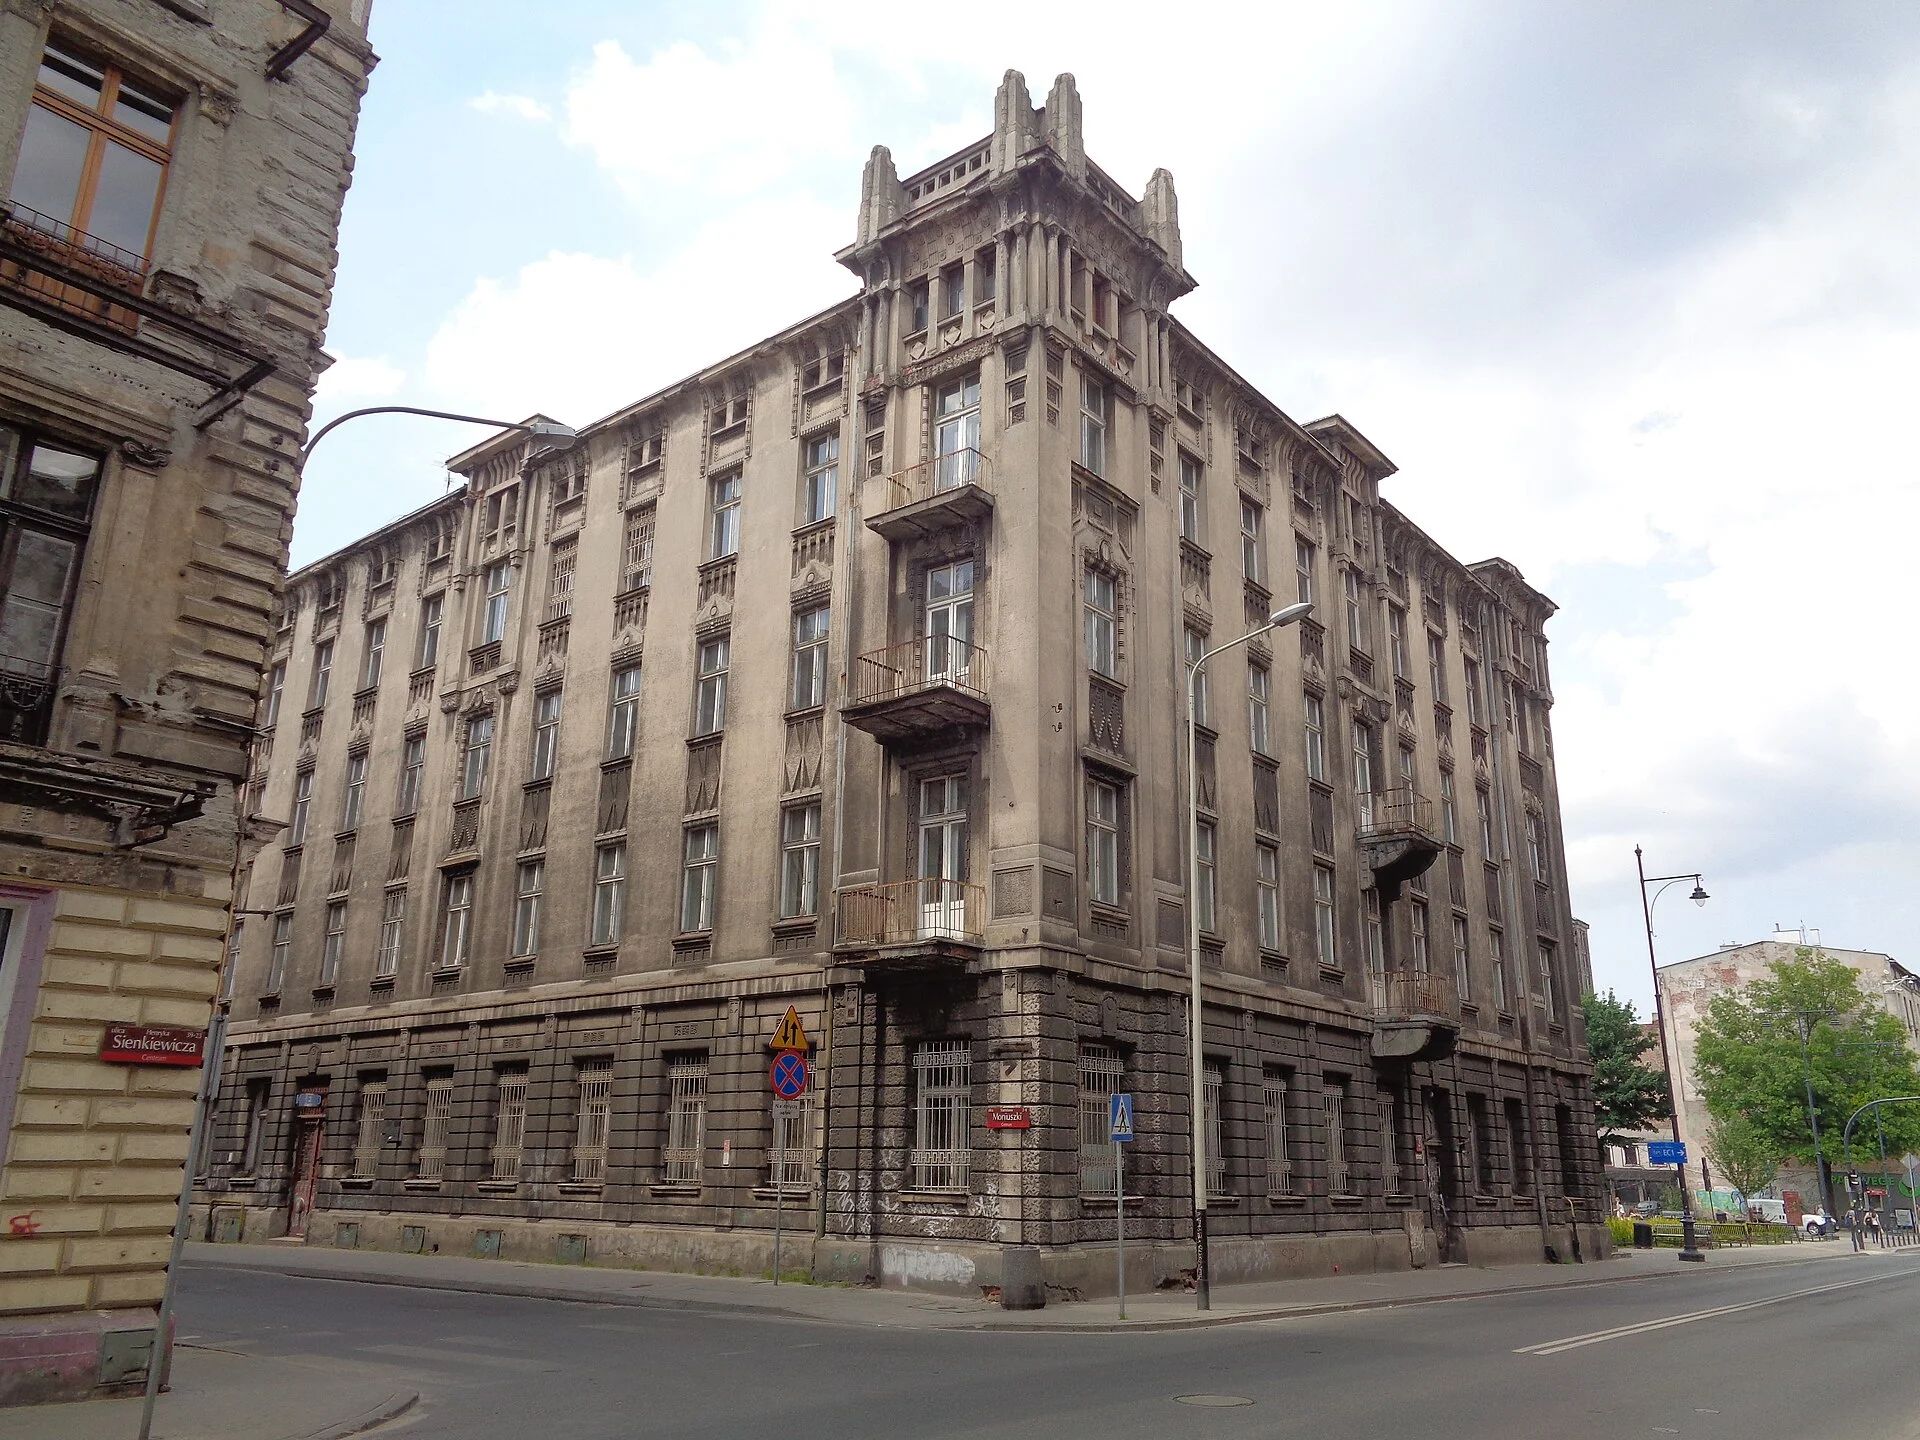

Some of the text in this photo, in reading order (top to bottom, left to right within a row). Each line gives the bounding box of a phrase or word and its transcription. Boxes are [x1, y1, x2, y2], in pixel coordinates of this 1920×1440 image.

[146, 1029, 170, 1037] Henryka
[112, 1035, 196, 1053] Sienkiewicza
[992, 1112, 1022, 1121] Moniuszki
